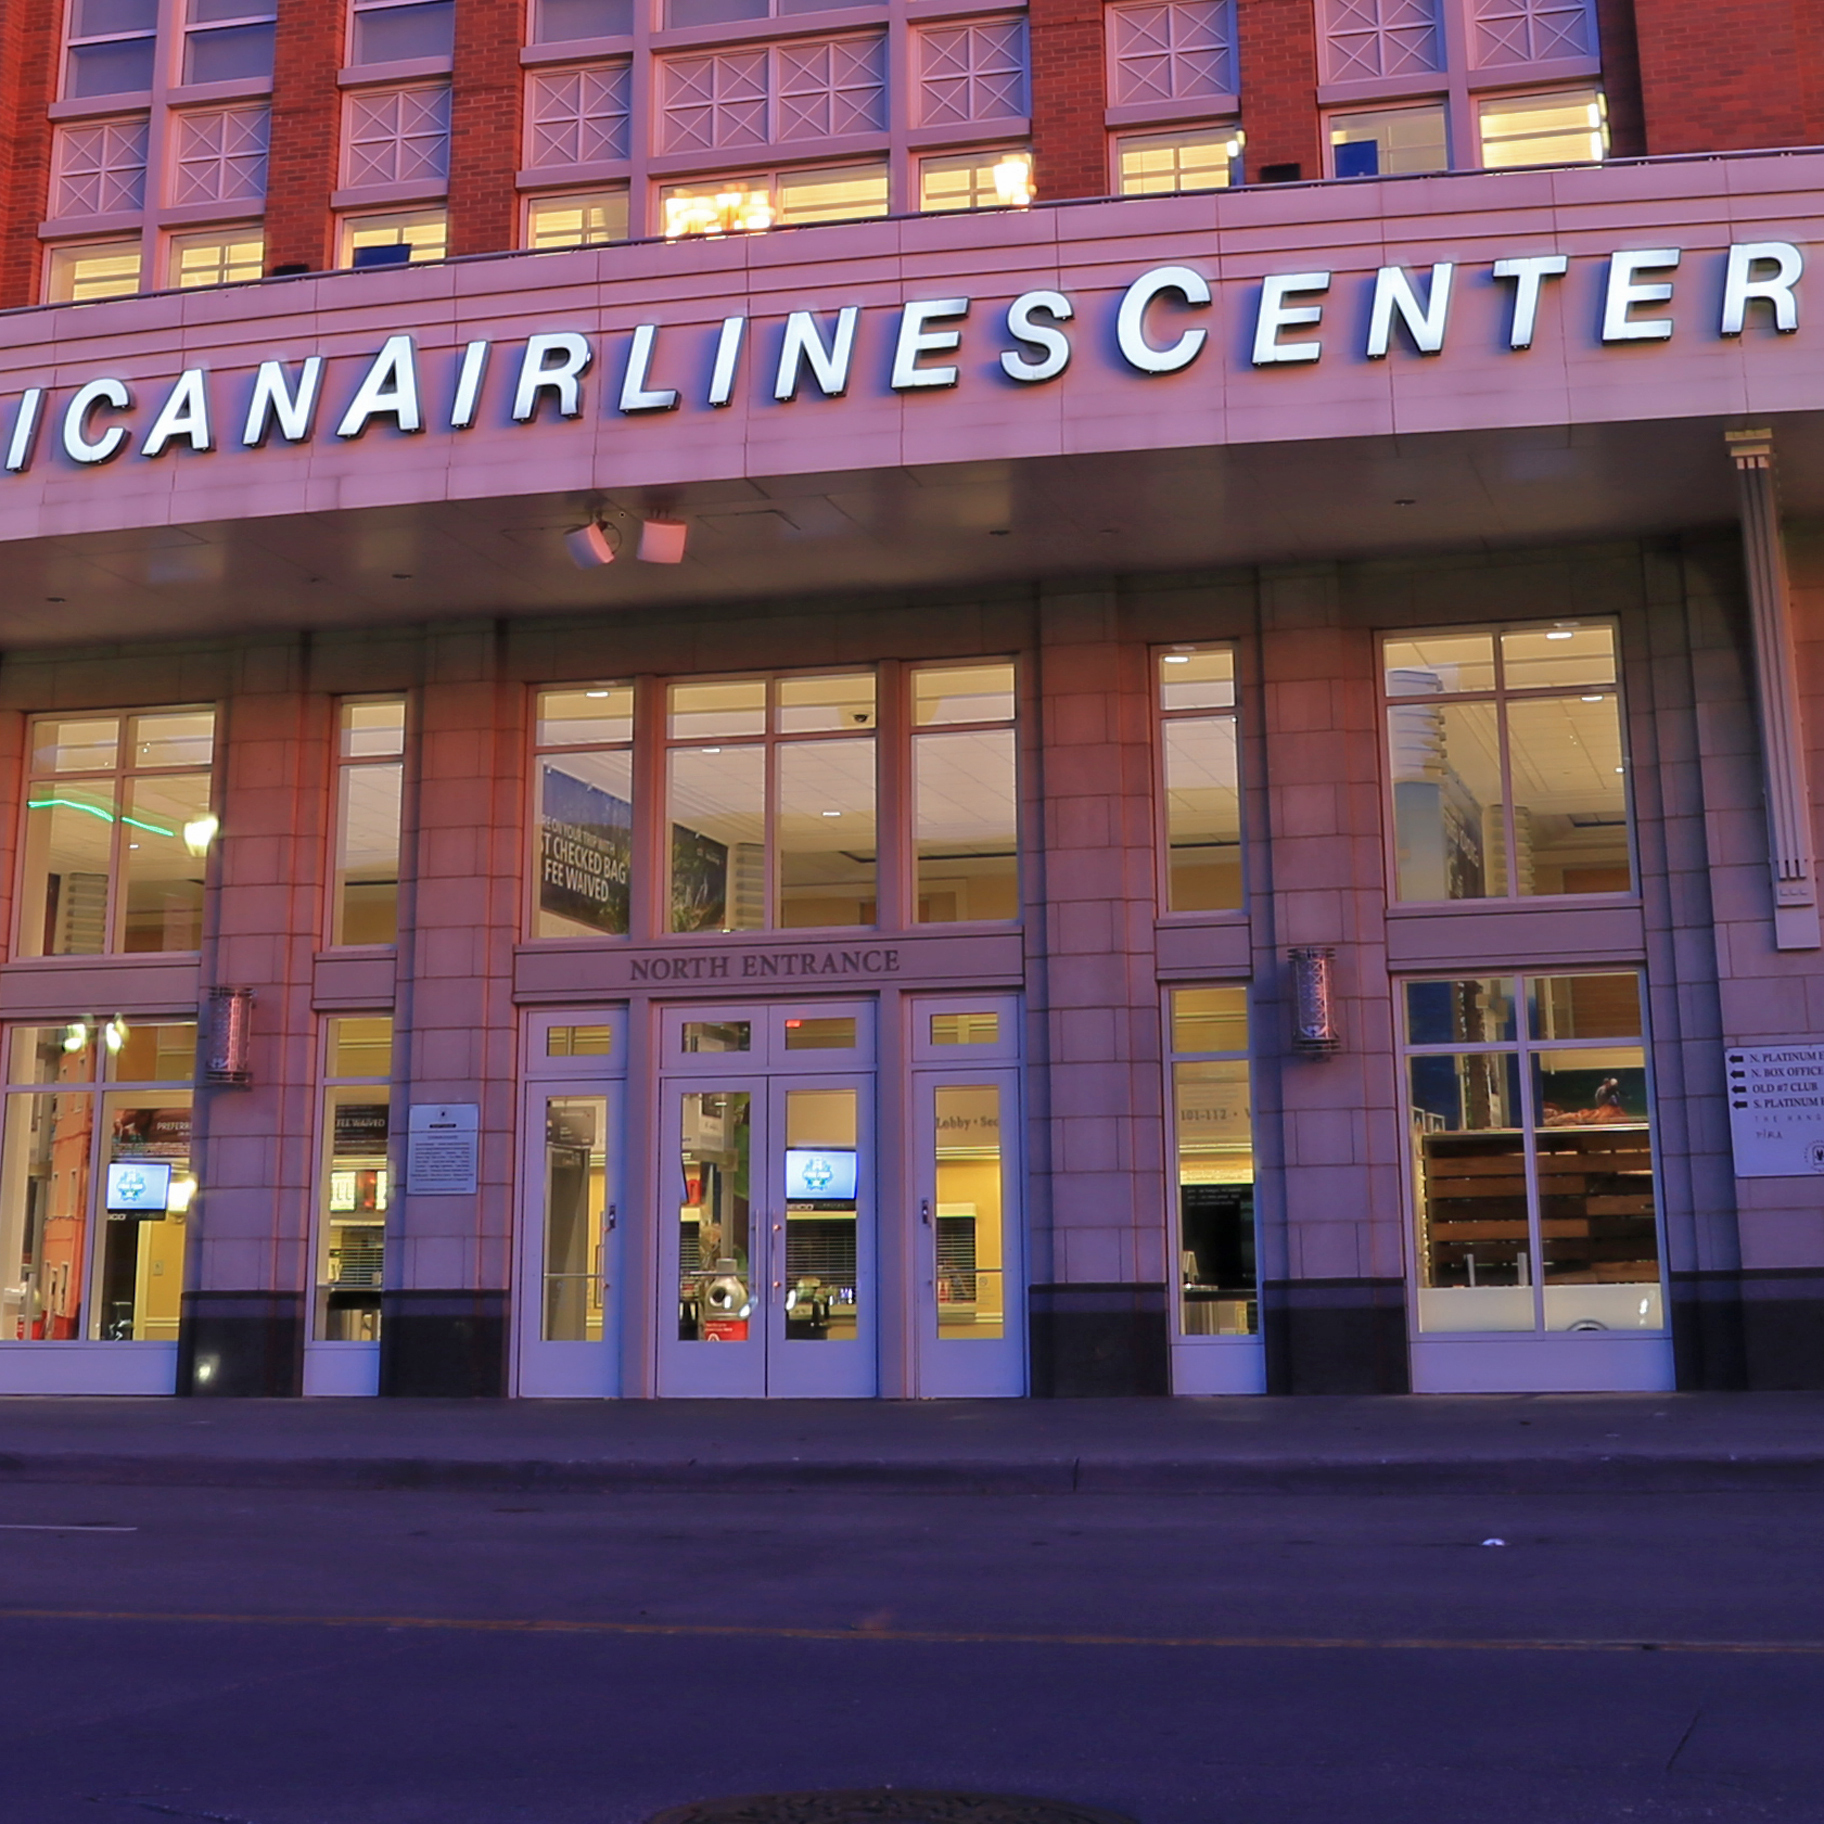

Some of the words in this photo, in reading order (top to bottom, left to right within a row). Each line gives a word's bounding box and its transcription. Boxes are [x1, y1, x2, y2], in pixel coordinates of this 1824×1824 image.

[553, 836, 603, 875] CHECKED
[603, 856, 626, 884] BAG
[544, 858, 564, 887] FEE
[565, 866, 609, 902] WAIVED
[629, 955, 730, 981] NORTH
[741, 949, 901, 977] ENTRANCE
[1749, 1053, 1760, 1063] N.
[1762, 1051, 1817, 1063] PLATINUM
[1751, 1068, 1762, 1078] N.
[1764, 1067, 1785, 1077] BOX
[1787, 1065, 1824, 1076] OFFICE
[1752, 1083, 1775, 1093] OLD
[1790, 1082, 1818, 1092] CLUB
[1753, 1099, 1762, 1109] S.
[1764, 1097, 1819, 1108] PLATINUM
[1180, 1108, 1227, 1121] 101-112
[936, 1116, 971, 1131] Lobby
